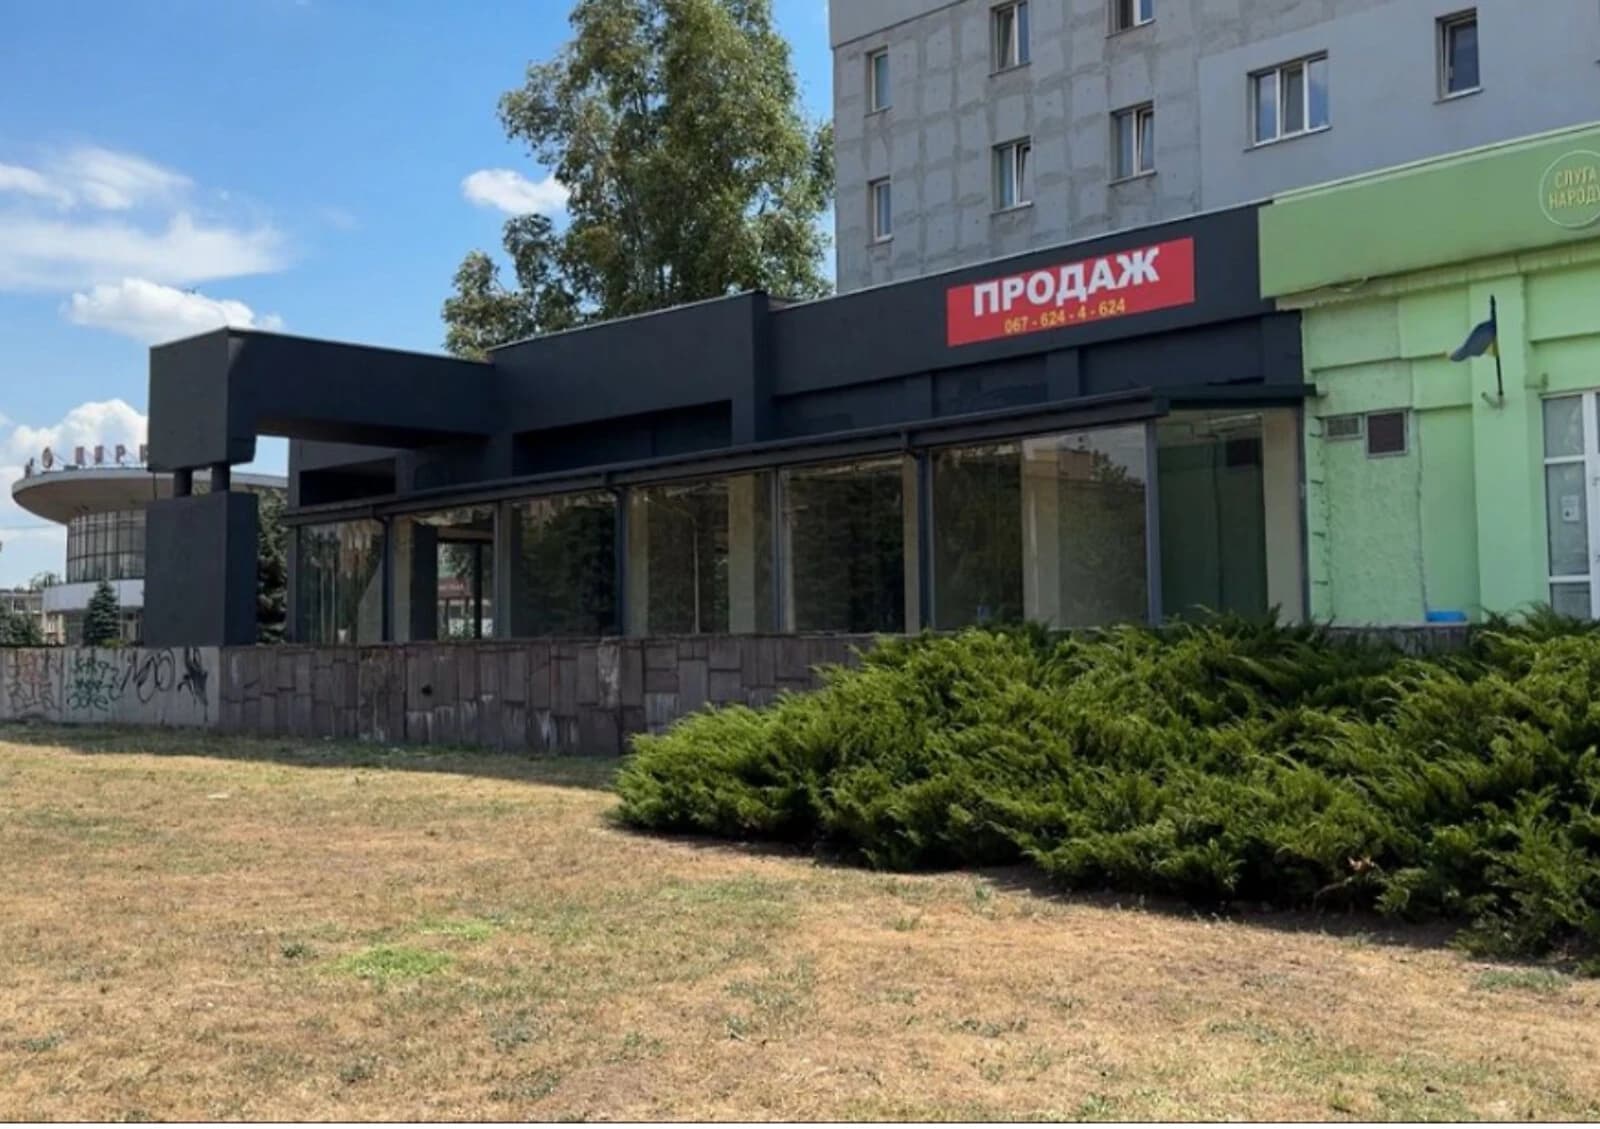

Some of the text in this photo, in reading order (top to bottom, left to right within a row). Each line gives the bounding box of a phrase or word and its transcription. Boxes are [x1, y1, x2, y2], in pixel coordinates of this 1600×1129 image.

[1554, 164, 1597, 188] СЛУГА
[973, 246, 1160, 317] ПРОДАЖ
[1004, 316, 1028, 335] 067
[1040, 309, 1065, 328] 624
[1077, 305, 1086, 319] 4
[1099, 297, 1126, 317] 624
